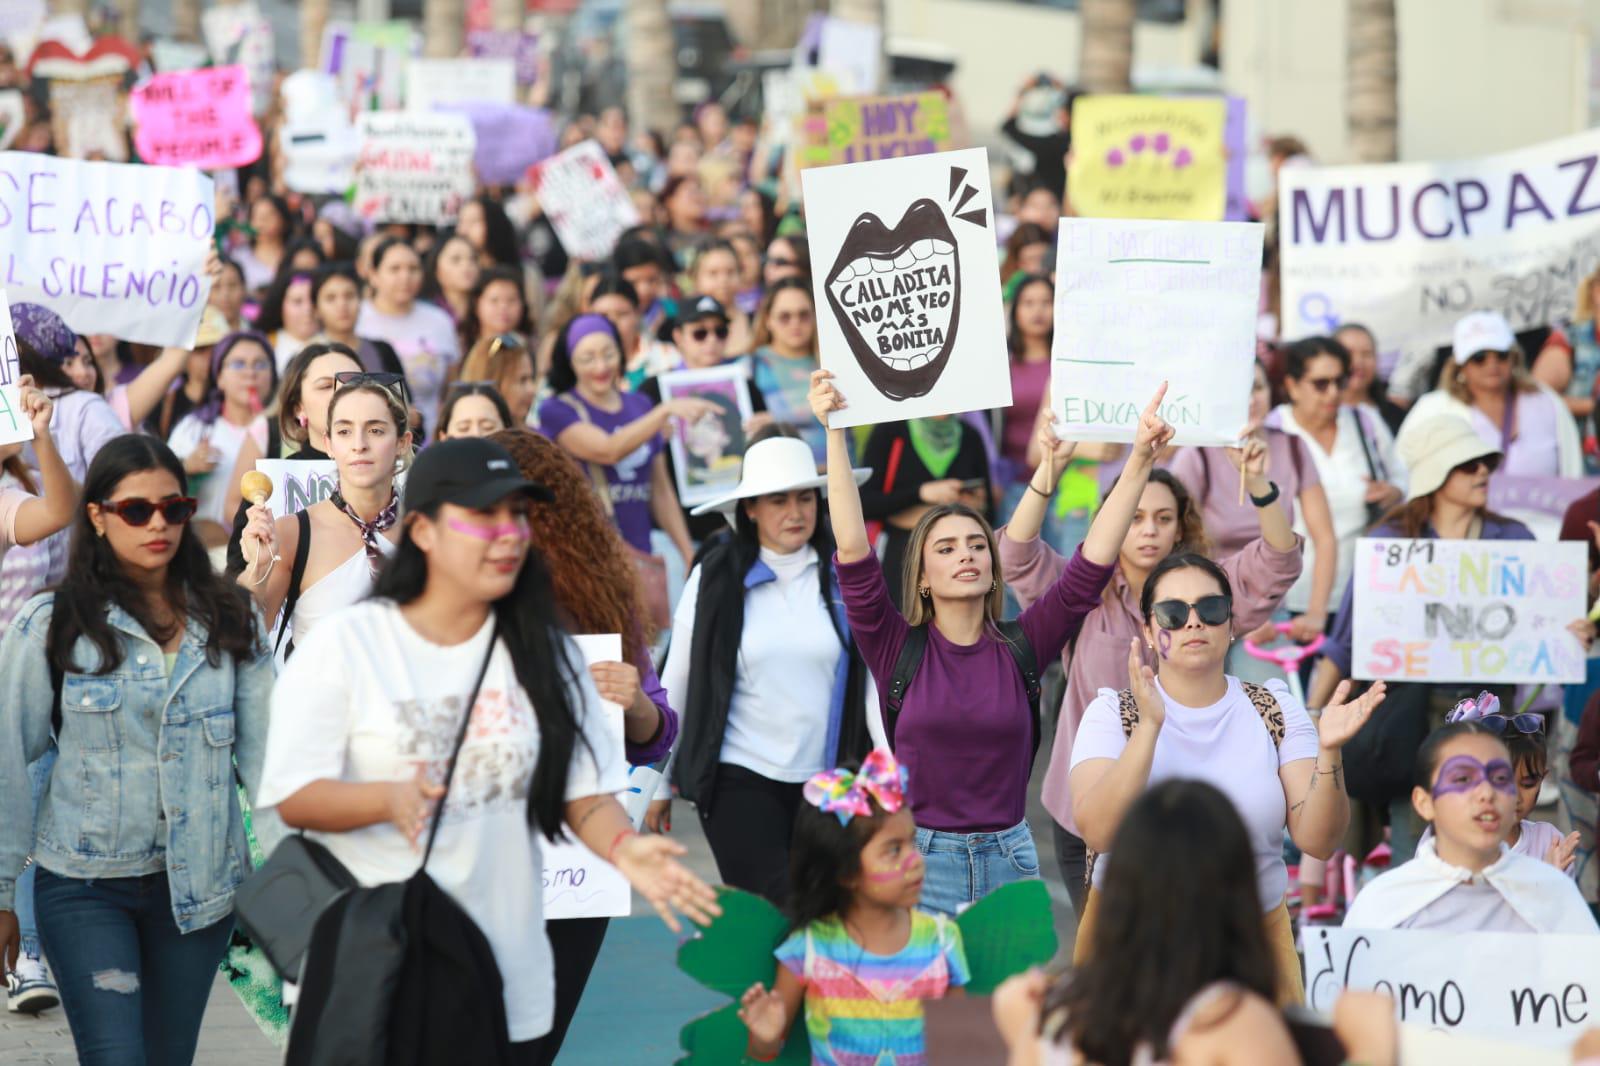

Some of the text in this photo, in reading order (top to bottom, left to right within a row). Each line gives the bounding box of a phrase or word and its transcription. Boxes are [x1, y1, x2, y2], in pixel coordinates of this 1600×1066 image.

[862, 100, 918, 136] HOY
[1292, 154, 1600, 244] MUCPAZ
[73, 197, 212, 241] ACABO
[839, 264, 951, 308] CALLADITA
[1420, 279, 1473, 315] NO
[851, 290, 950, 327] NO ME VEO
[877, 313, 929, 334] MÁS
[876, 327, 945, 355] BONITA
[1064, 394, 1200, 426] EDUCAIÓN
[1425, 602, 1517, 640] NO
[1367, 639, 1431, 677] SE
[1511, 982, 1589, 1029] me
